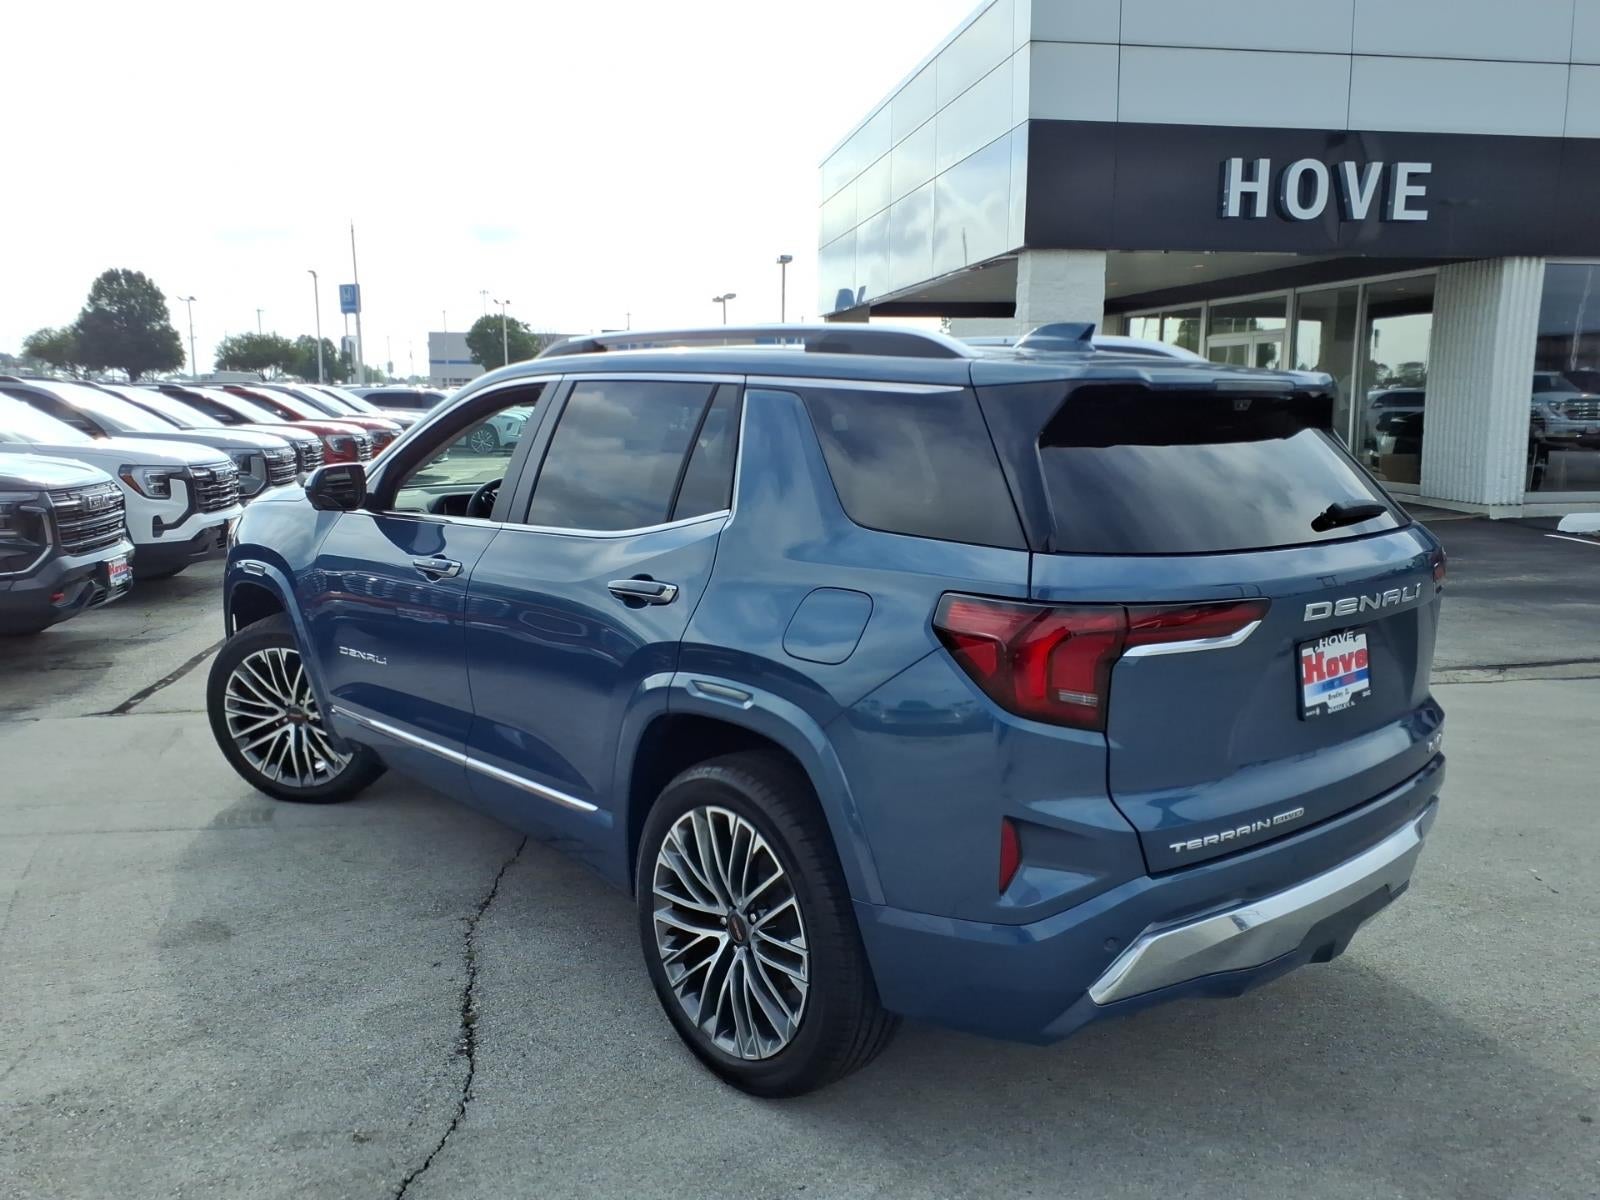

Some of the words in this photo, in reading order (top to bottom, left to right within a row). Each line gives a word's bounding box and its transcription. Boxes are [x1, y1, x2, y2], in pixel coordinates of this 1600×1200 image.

[1222, 157, 1432, 221] HOVE
[1303, 582, 1421, 622] DENALI
[339, 646, 387, 665] DENALI
[1319, 631, 1354, 648] HOVE
[1303, 648, 1368, 685] Hove
[1169, 818, 1271, 853] TERRAIN
